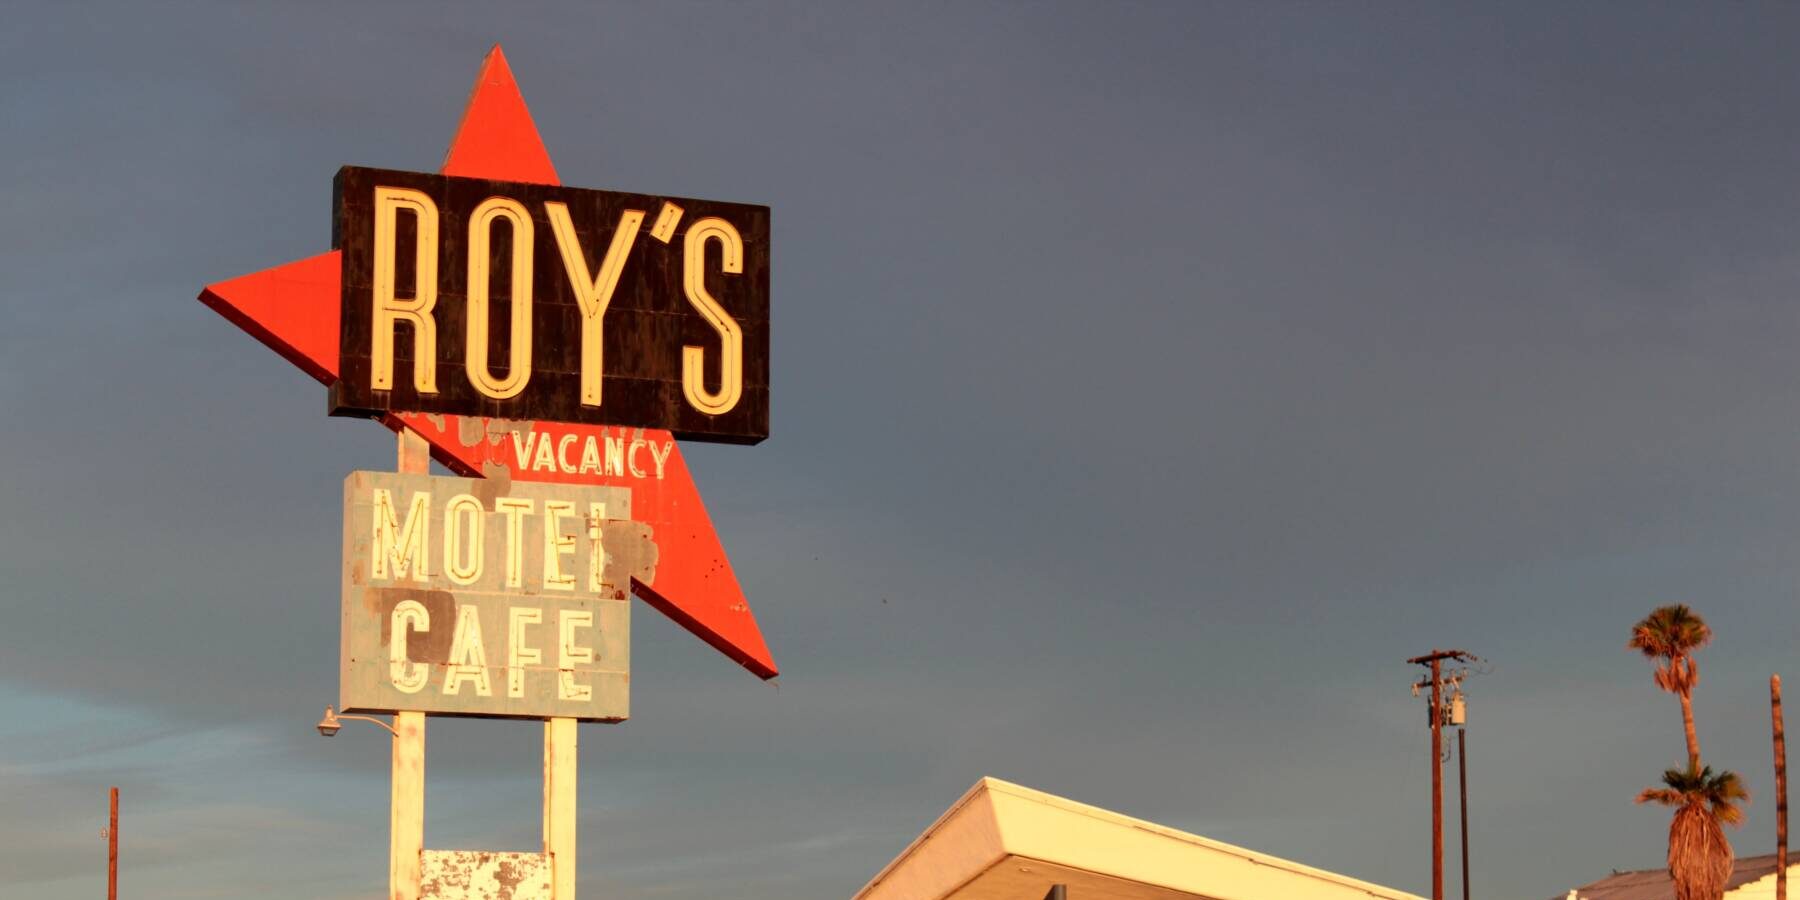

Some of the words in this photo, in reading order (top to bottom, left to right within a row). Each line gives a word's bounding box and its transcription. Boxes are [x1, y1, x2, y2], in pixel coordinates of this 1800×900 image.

[371, 185, 744, 415] ROY'S
[511, 430, 674, 479] VACANCY
[390, 600, 593, 701] CAFE
